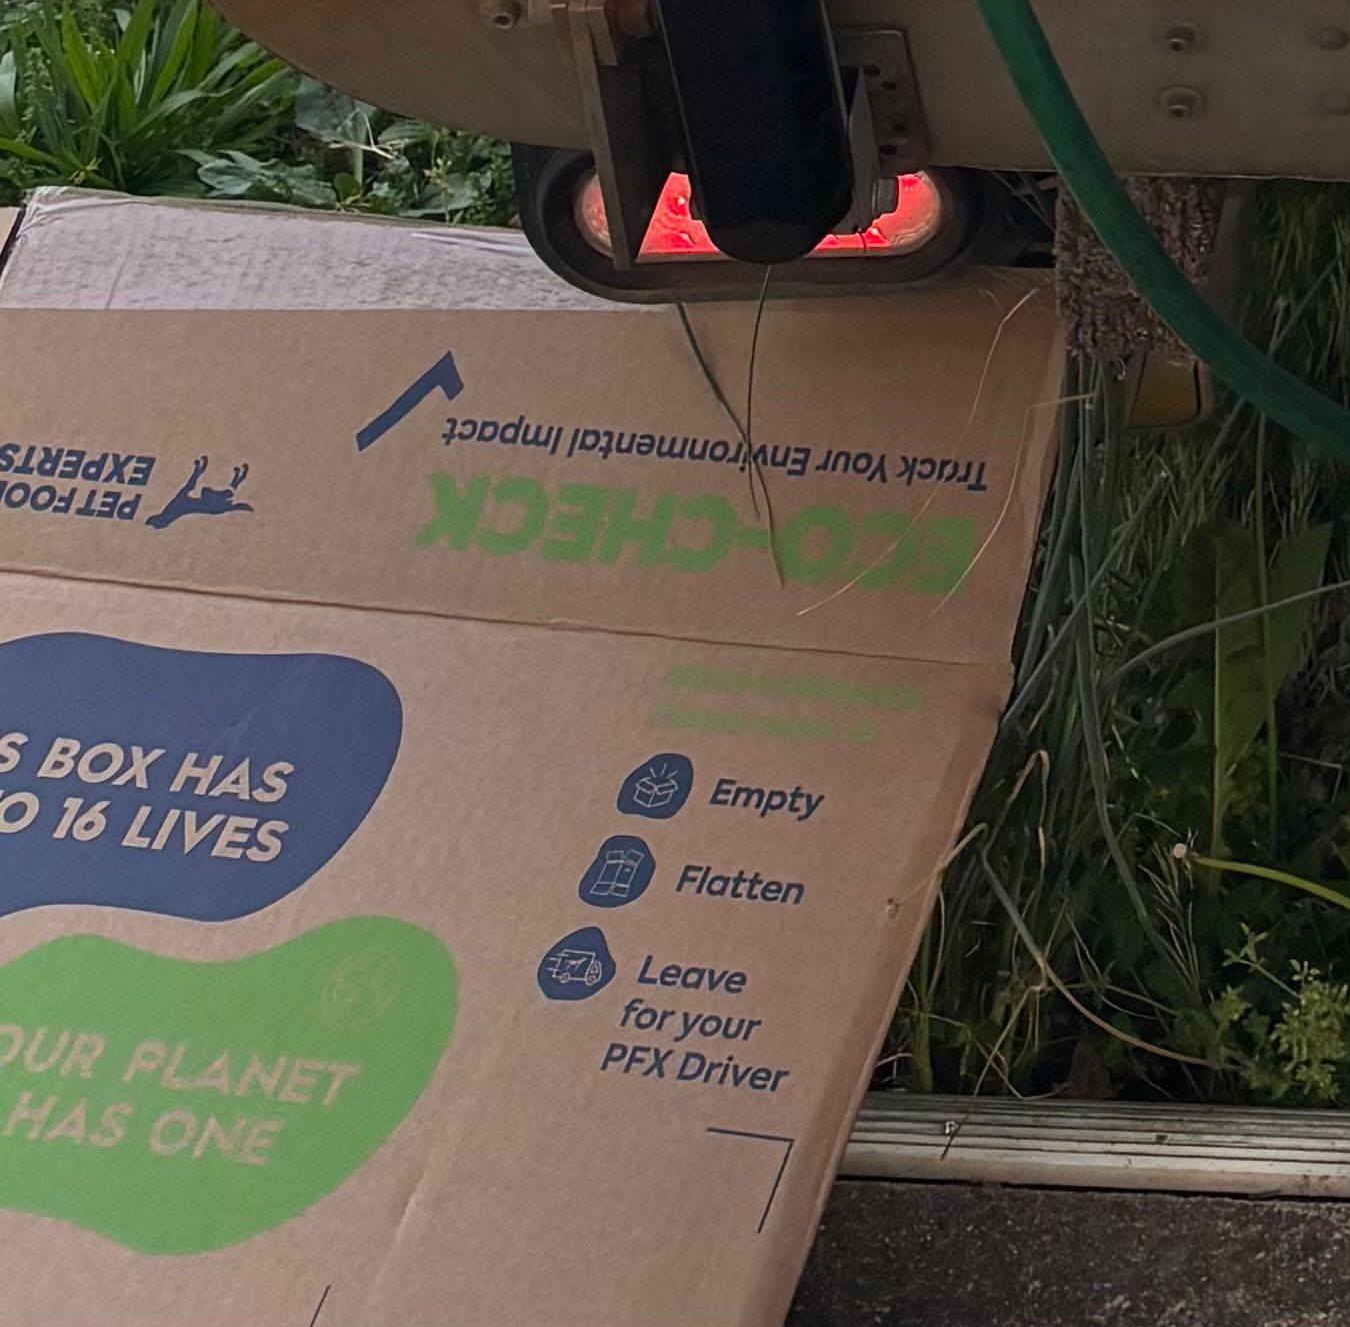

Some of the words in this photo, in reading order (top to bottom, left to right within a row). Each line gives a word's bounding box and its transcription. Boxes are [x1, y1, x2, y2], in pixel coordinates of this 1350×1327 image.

[441, 415, 563, 456] Impact
[566, 428, 812, 477] Environmental
[0, 443, 157, 487] EXPERTS
[815, 449, 889, 484] Your
[895, 454, 988, 492] Track
[0, 479, 77, 515] FOO
[76, 488, 143, 521] PET
[414, 471, 979, 600] ECO-CHECK
[37, 736, 166, 789] BOX
[169, 752, 296, 803] HAS
[709, 777, 825, 822] Empty
[52, 796, 112, 842] 16
[121, 805, 290, 863] LIVES
[675, 864, 805, 906] Flatten
[637, 954, 748, 994] Leave
[619, 997, 676, 1032] for
[673, 1010, 762, 1042] your
[121, 1039, 364, 1108] PLANET
[600, 1042, 675, 1079] PFX
[677, 1051, 790, 1092] Driver
[1, 1090, 135, 1148] HAS
[147, 1108, 285, 1166] ONE
